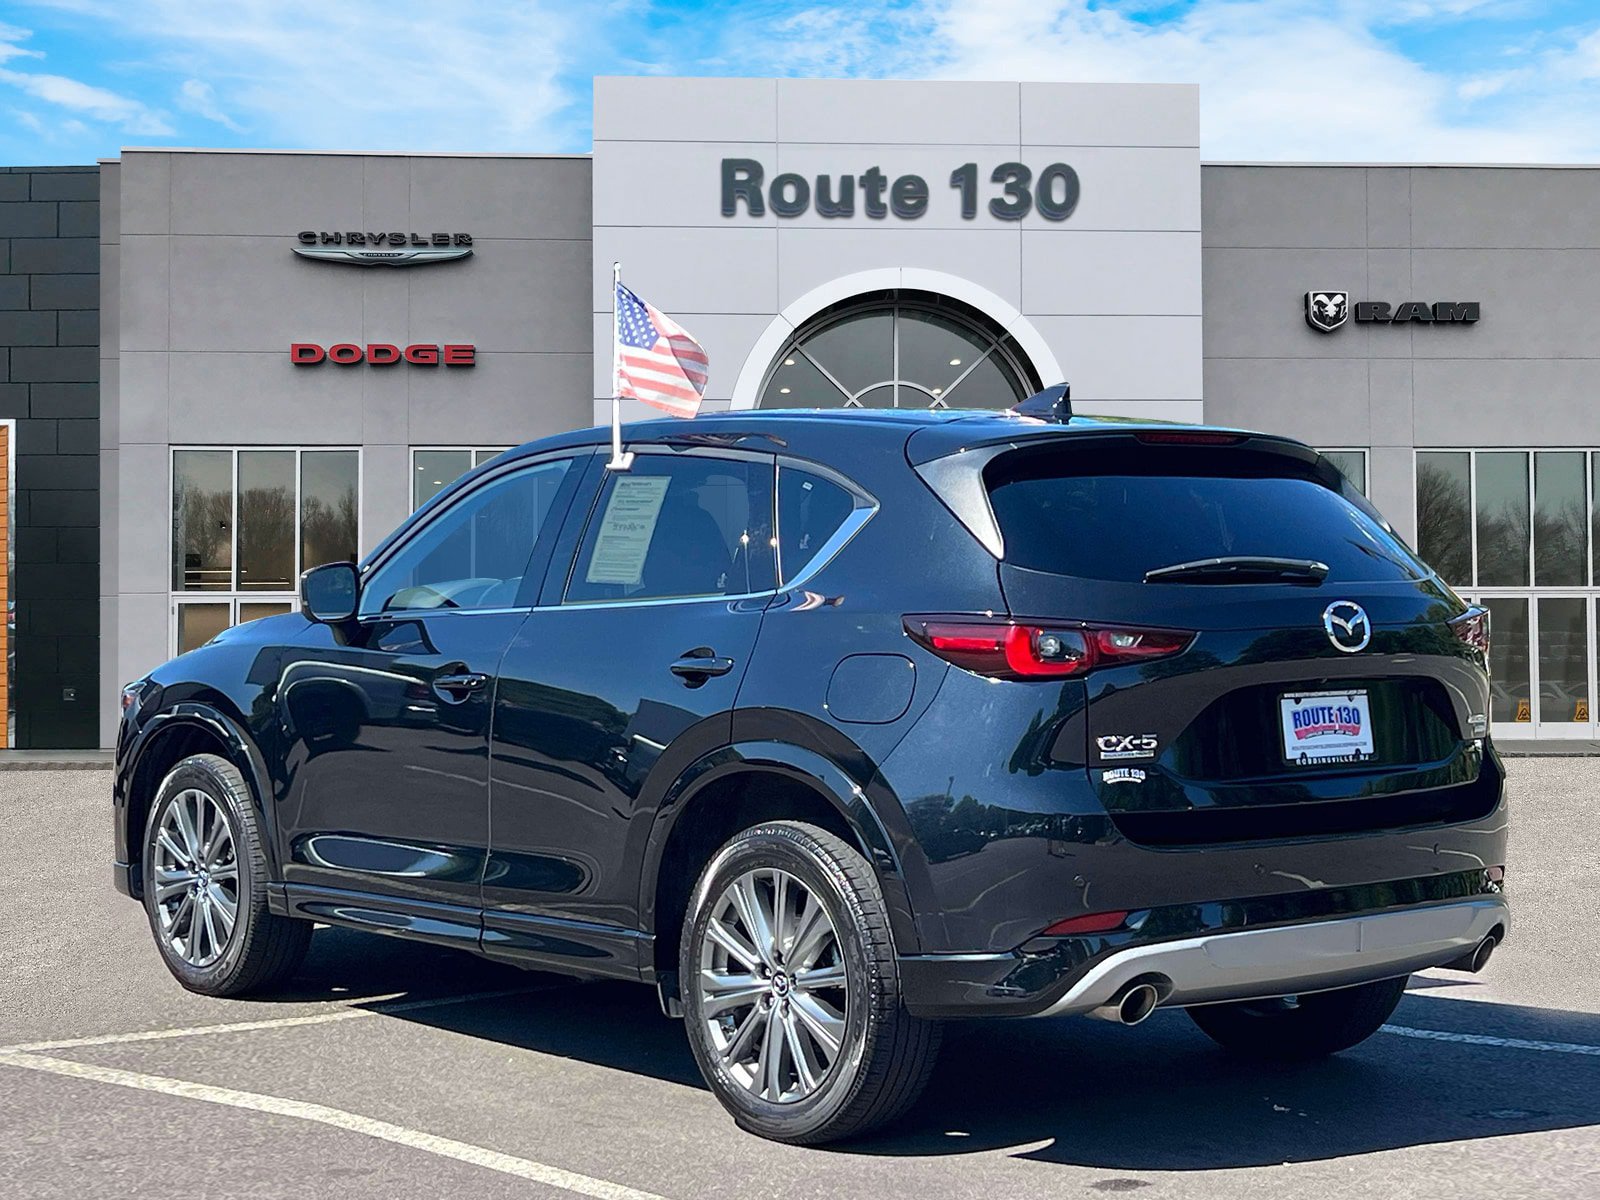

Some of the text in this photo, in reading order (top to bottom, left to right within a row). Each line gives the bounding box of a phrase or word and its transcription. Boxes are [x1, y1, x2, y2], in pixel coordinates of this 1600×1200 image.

[721, 158, 1081, 220] Route 130
[298, 231, 473, 245] CHRYSLER
[1355, 302, 1480, 323] RAM
[291, 343, 476, 366] DODGE
[1292, 706, 1361, 729] ROUTE 130
[1096, 734, 1158, 751] CX-5
[1102, 768, 1129, 782] ROUTE
